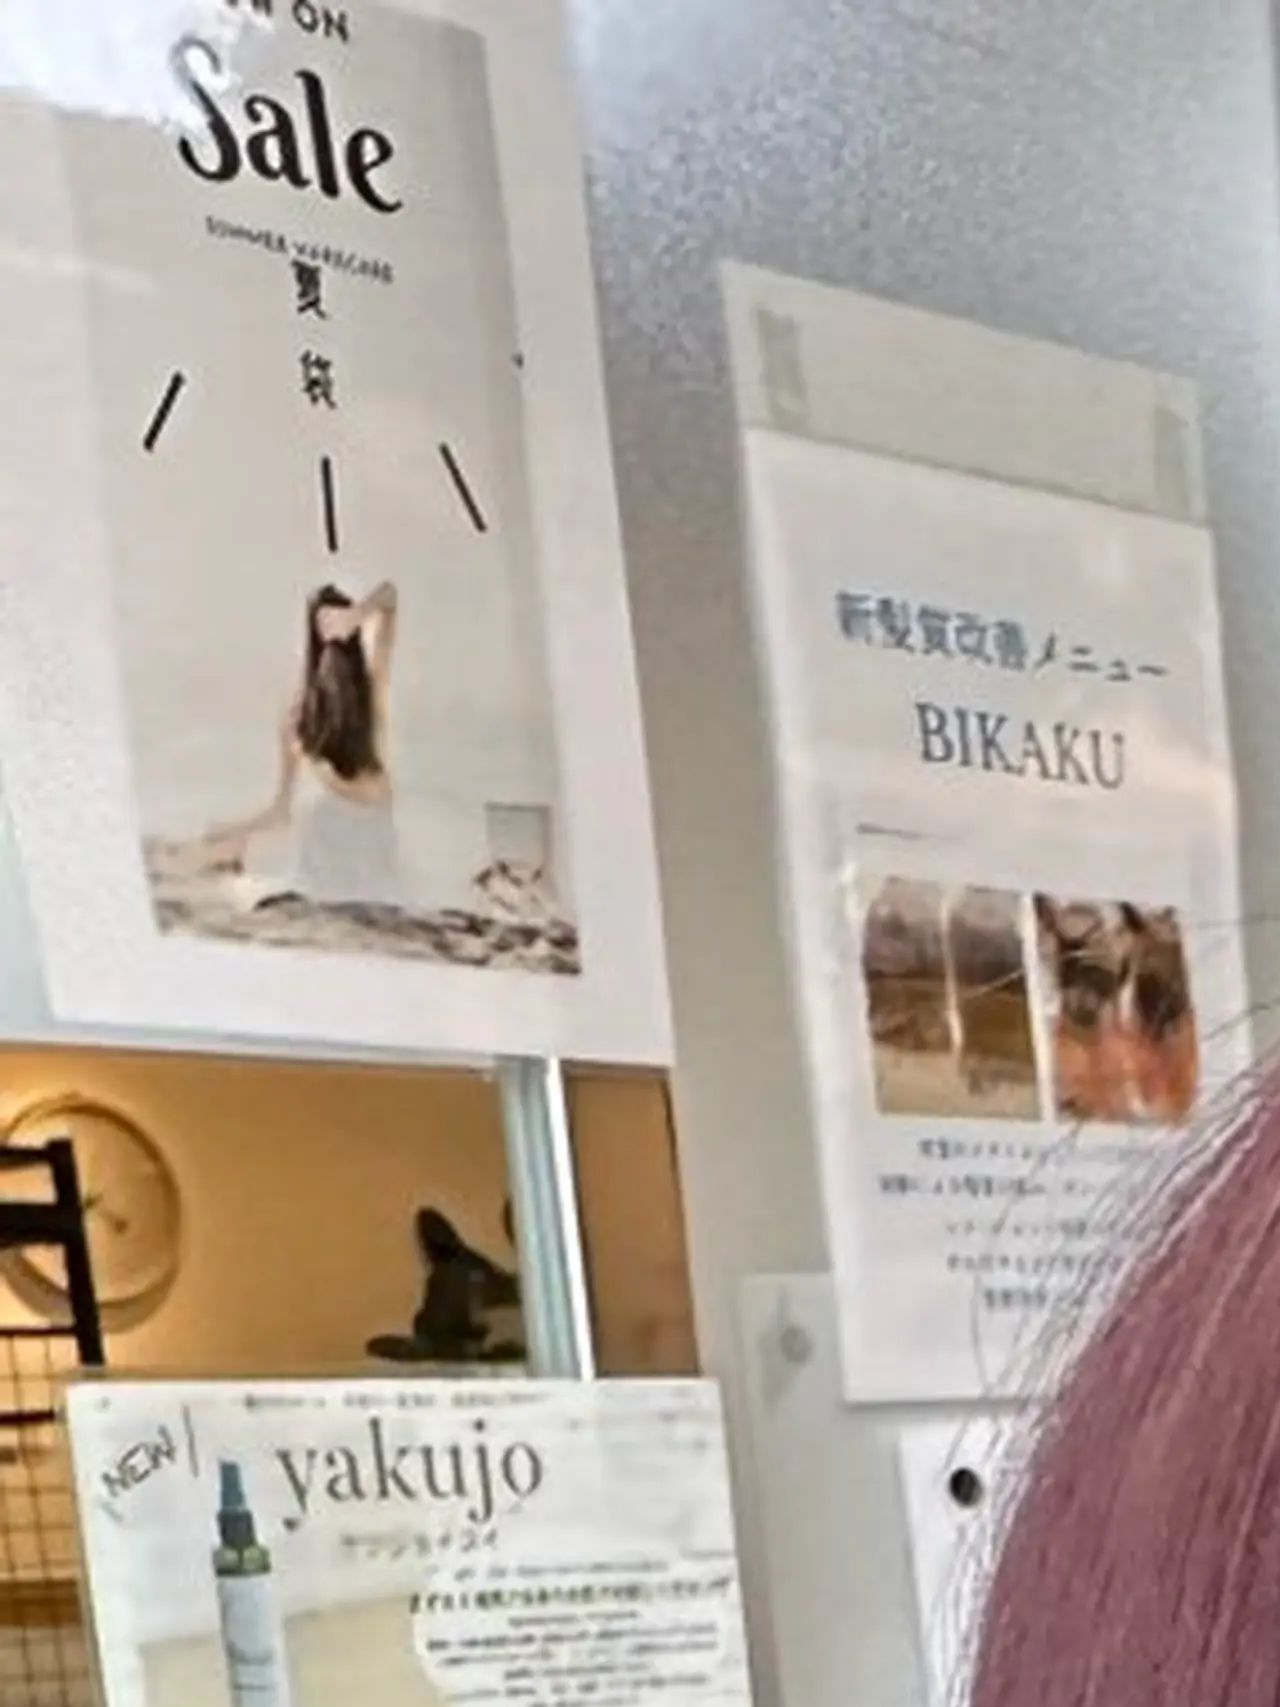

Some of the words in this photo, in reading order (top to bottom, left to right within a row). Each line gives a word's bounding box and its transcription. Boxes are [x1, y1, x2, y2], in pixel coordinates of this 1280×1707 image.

[291, 0, 350, 43] ON
[169, 36, 404, 214] Sale
[914, 700, 1126, 790] BIKAKU
[100, 1424, 177, 1499] NEW
[275, 1415, 545, 1533] yakujo
